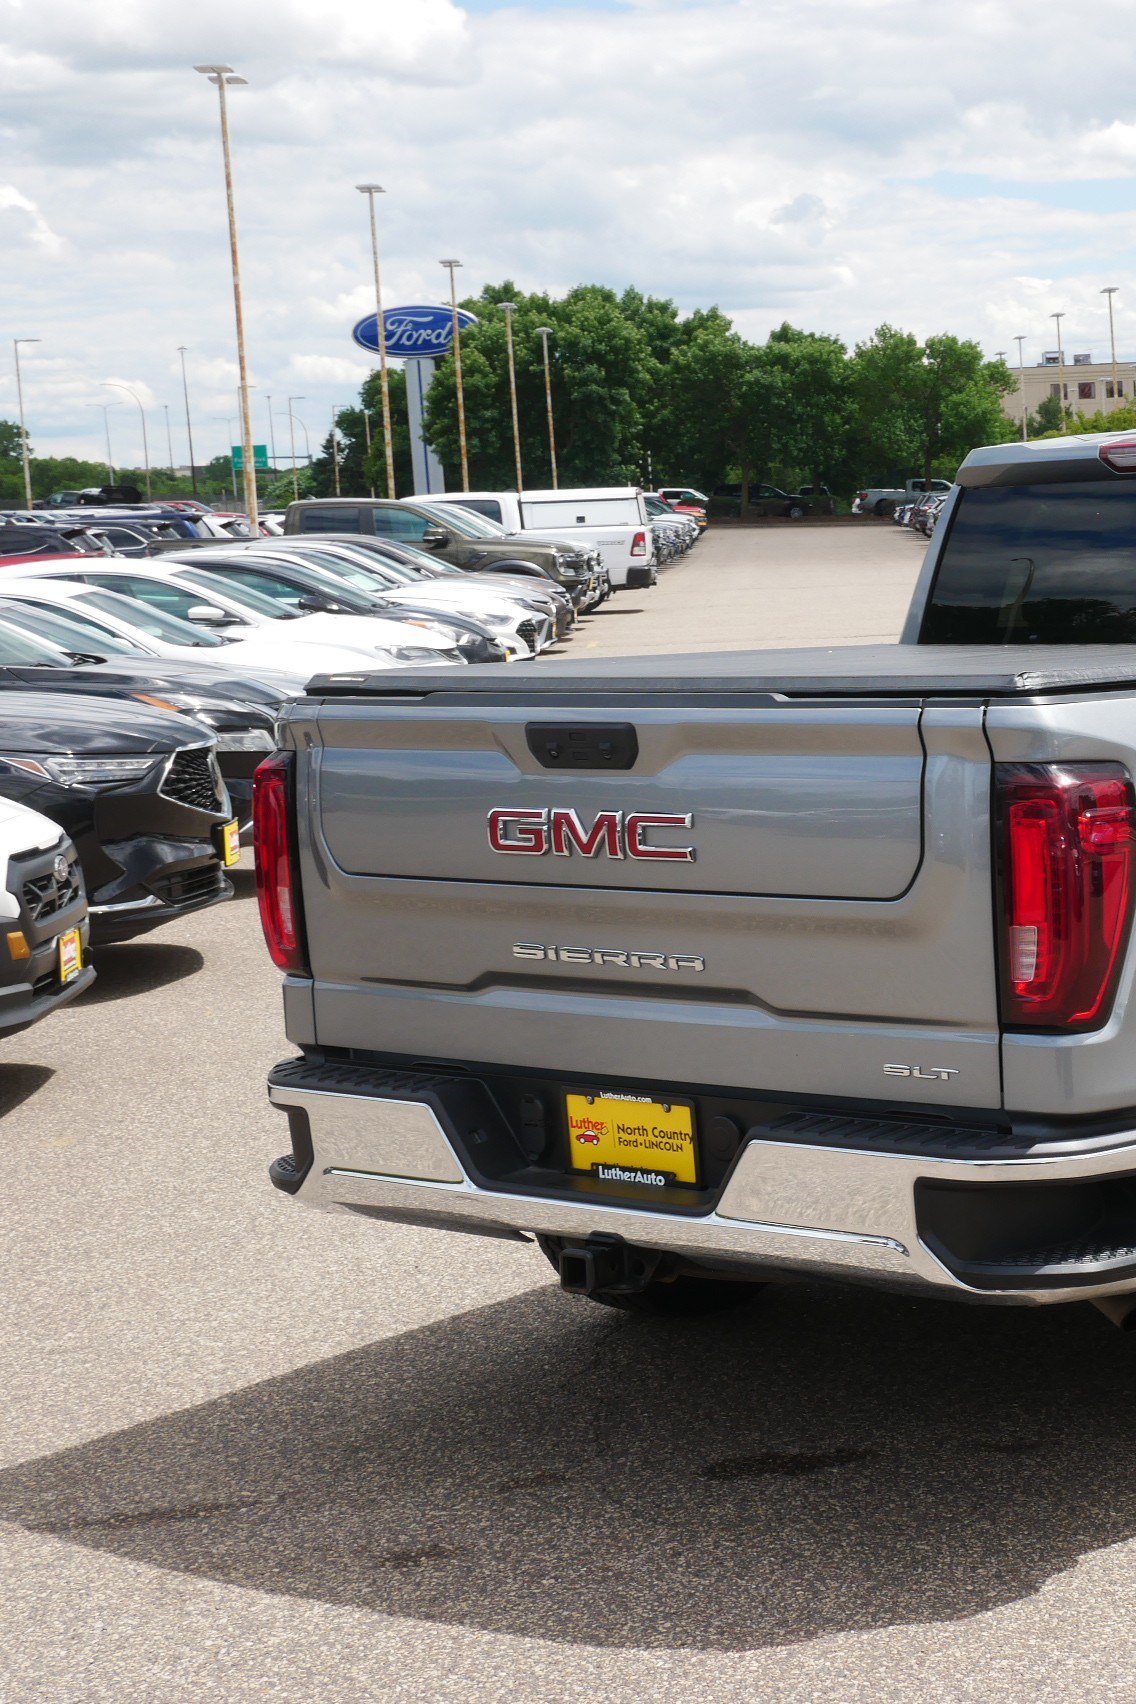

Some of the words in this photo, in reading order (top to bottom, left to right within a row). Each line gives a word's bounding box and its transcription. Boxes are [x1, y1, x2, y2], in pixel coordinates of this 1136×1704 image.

[384, 315, 453, 346] Ford
[487, 805, 697, 863] GMC
[512, 942, 706, 972] SIERRA
[883, 1062, 960, 1081] SLT
[600, 1091, 653, 1104] LutherAuto.com
[570, 1115, 605, 1131] Luther
[617, 1123, 649, 1138] North
[651, 1126, 693, 1145] Country
[598, 1165, 666, 1186] LutherAuto
